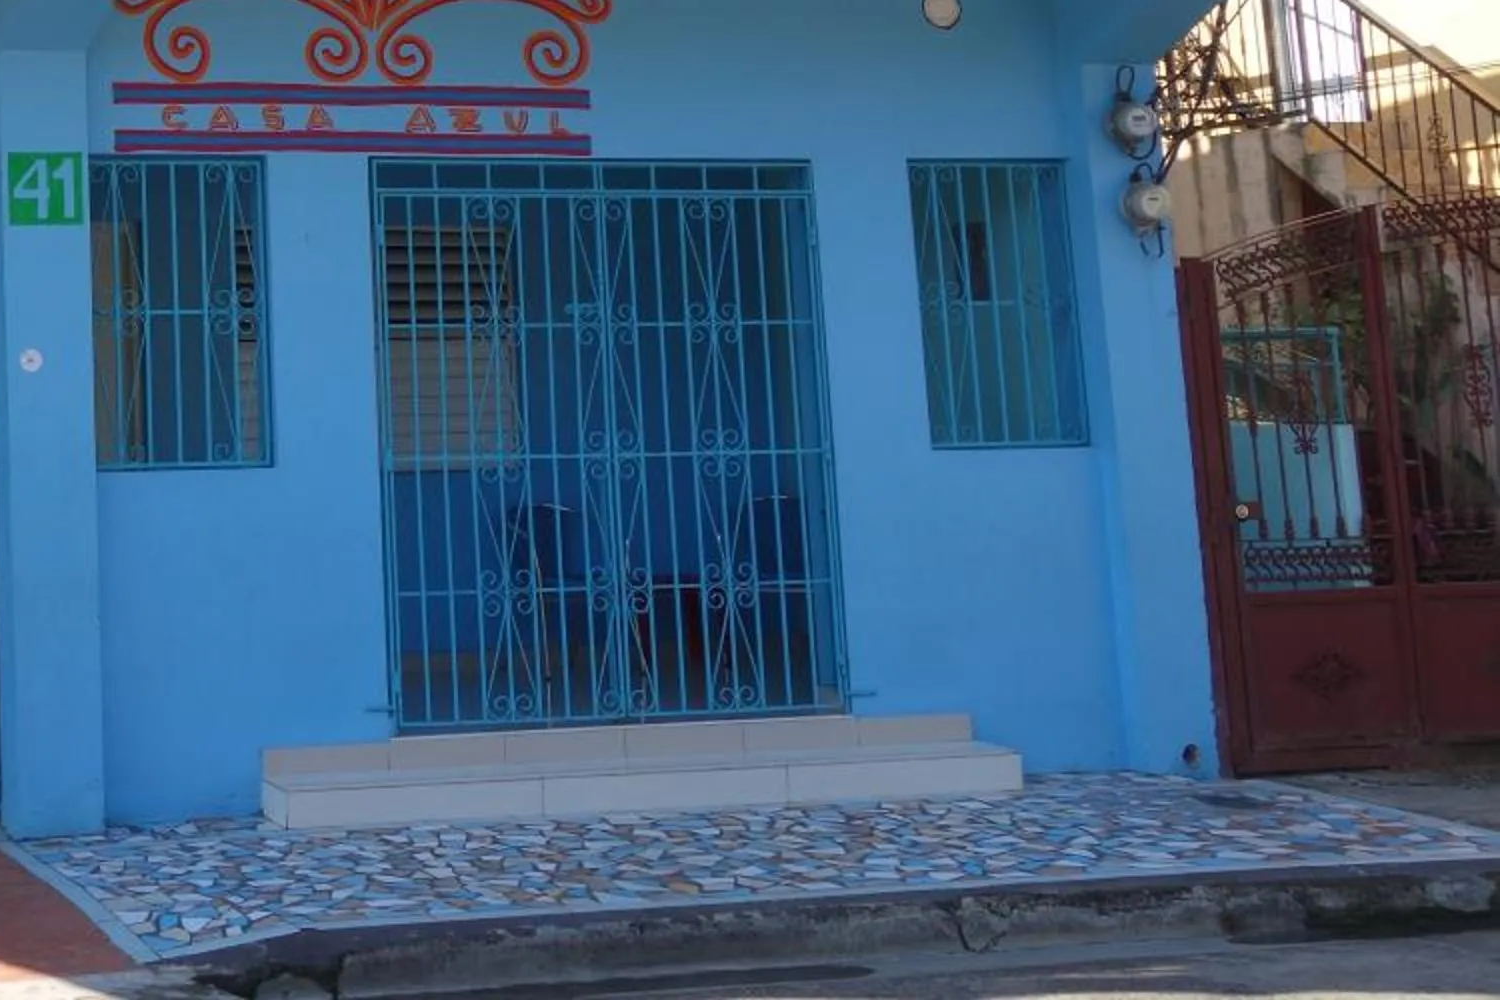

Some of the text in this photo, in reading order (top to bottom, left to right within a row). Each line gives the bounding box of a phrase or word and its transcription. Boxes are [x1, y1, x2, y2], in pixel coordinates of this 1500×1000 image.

[161, 104, 569, 135] CASA AZUL
[13, 158, 75, 219] 41
